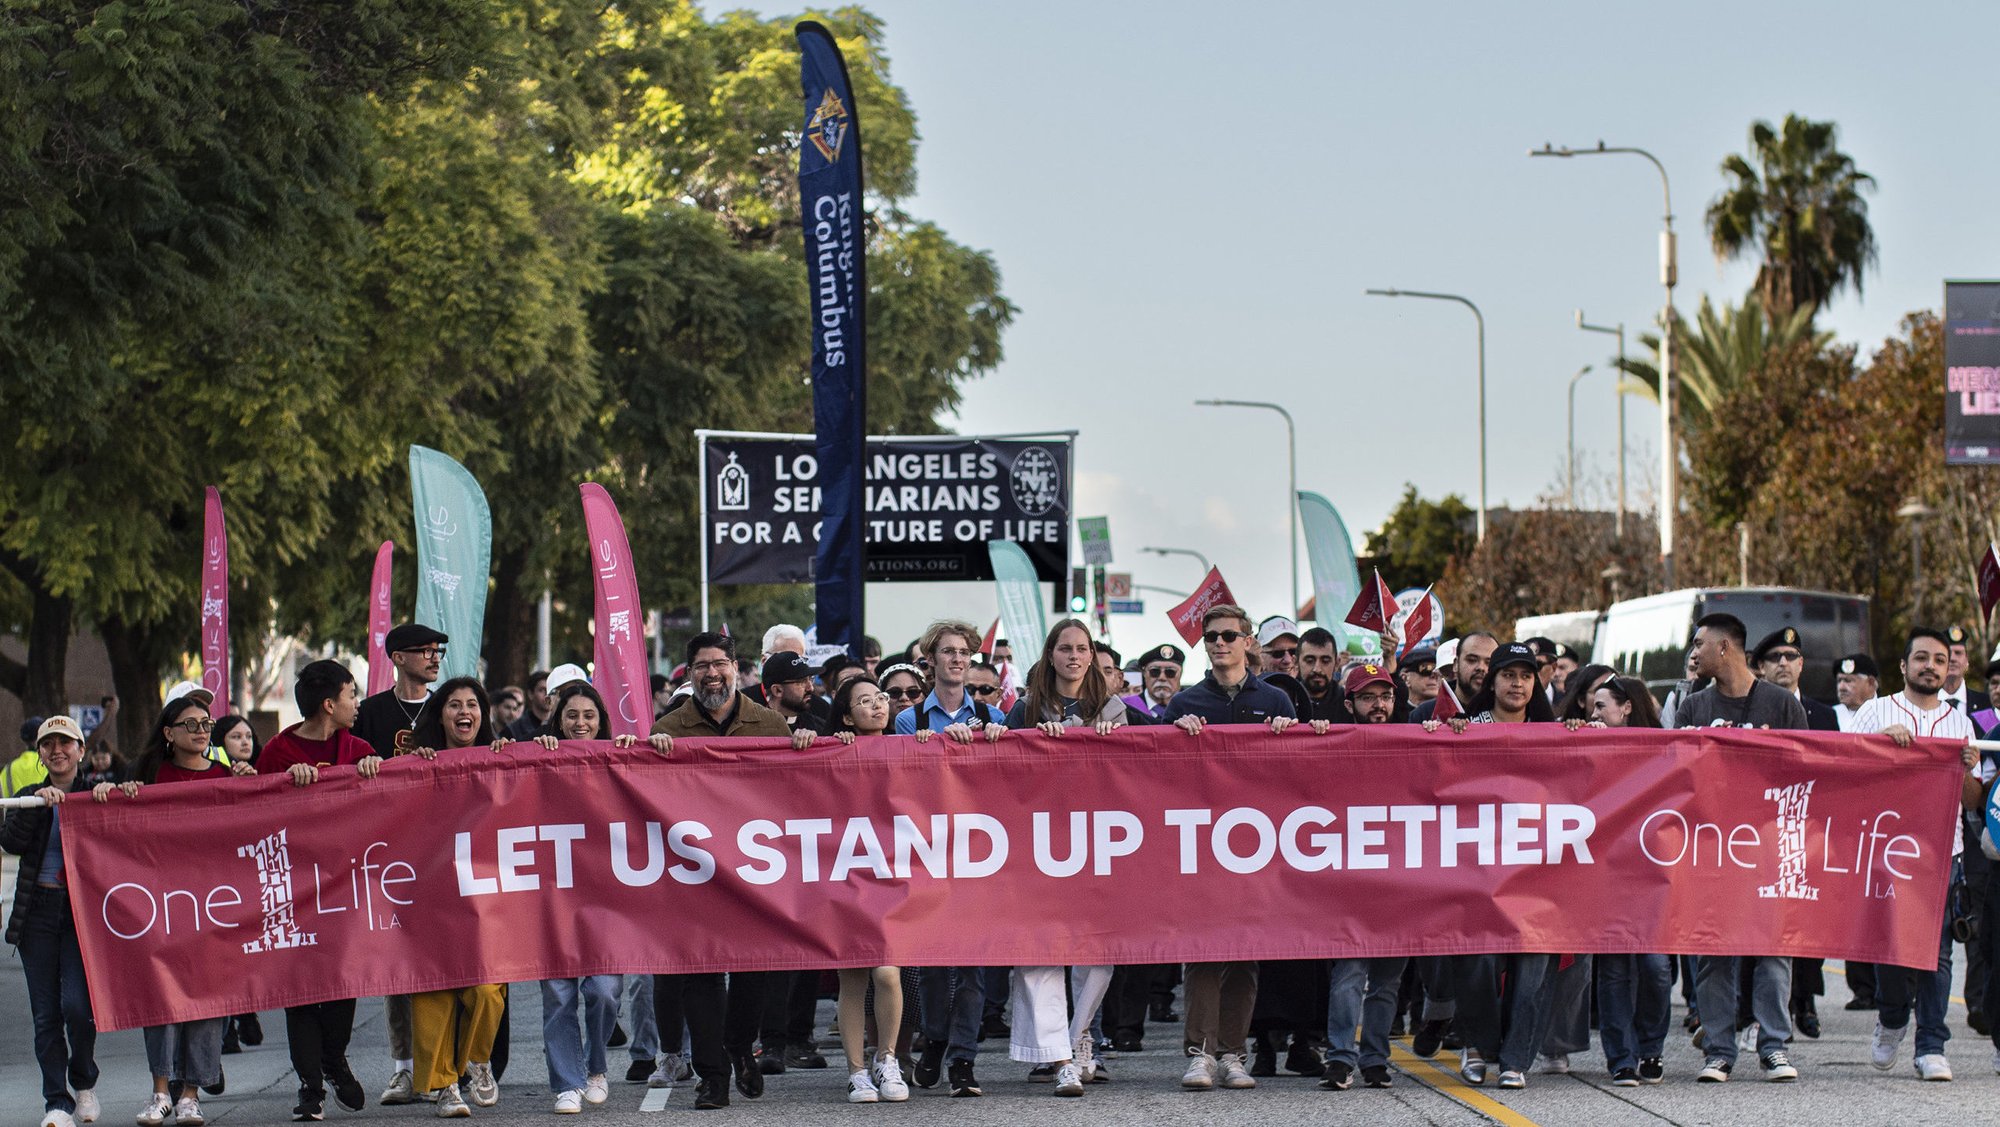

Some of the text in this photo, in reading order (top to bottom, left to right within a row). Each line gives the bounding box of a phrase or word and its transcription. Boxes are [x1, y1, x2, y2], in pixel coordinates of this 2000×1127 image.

[815, 195, 846, 367] Columbus
[775, 454, 818, 481] LO
[773, 486, 1001, 513] SEARIANS
[714, 521, 772, 544] FOR
[782, 521, 803, 544] A
[812, 519, 943, 544] CTURE
[954, 519, 995, 543] OF
[1004, 519, 1059, 543] LIFE
[866, 559, 960, 572] ATIONS.ORG
[455, 803, 1597, 897] LET US STAND UP TOGETHER
[1638, 808, 1761, 869] One
[1823, 810, 1921, 898] Life
[102, 882, 242, 940] One
[314, 841, 417, 931] Life
[1875, 882, 1897, 900] LA
[378, 913, 403, 931] LA
